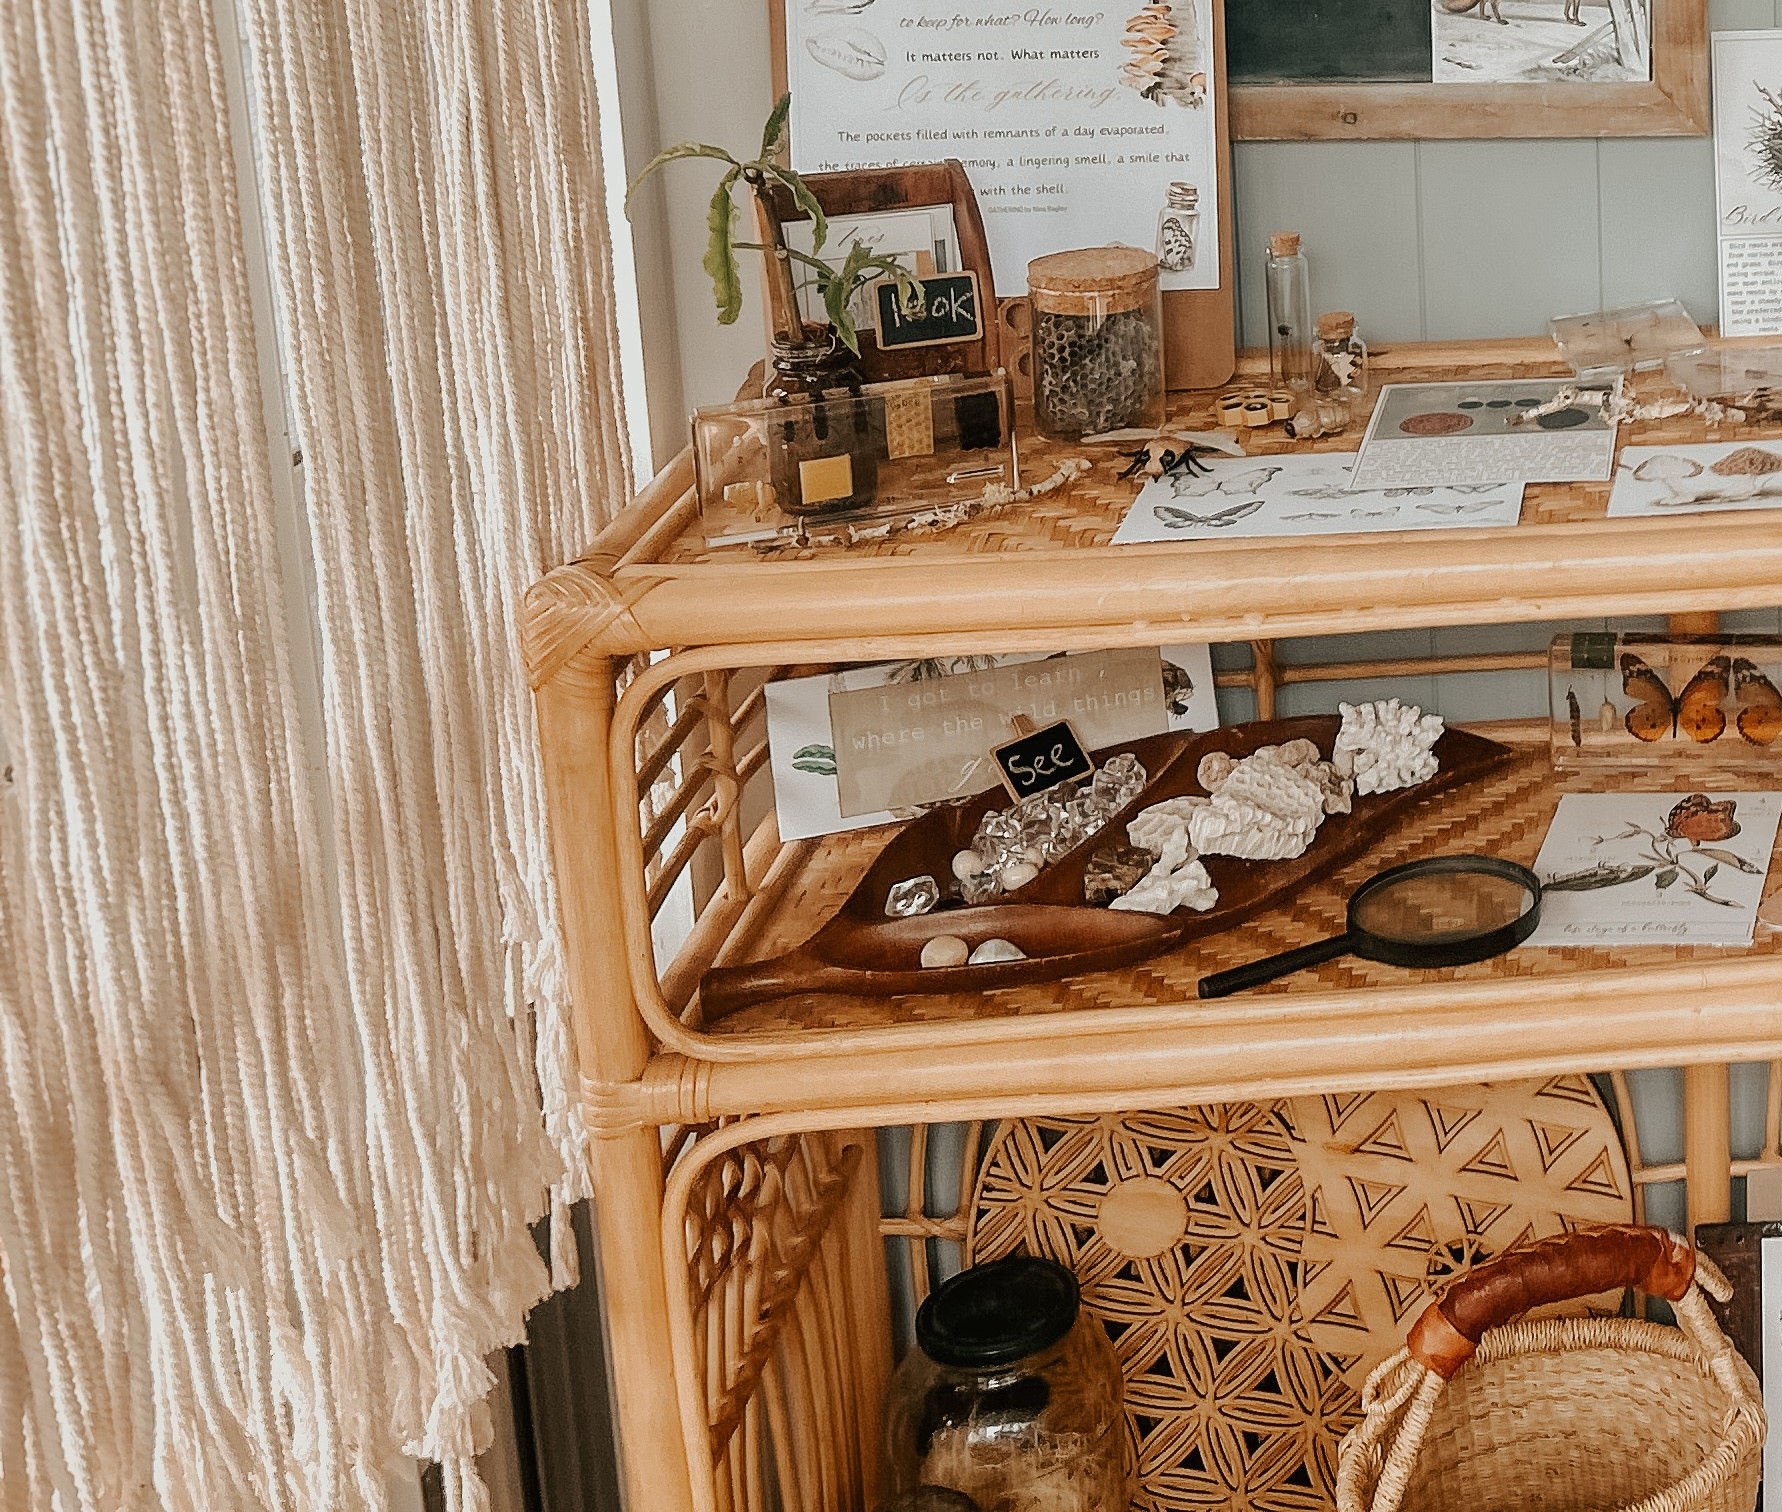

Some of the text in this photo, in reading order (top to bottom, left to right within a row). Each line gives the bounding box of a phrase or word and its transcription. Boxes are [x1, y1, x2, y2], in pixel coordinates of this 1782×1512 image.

[906, 50, 917, 64] It
[921, 51, 972, 63] matters
[1010, 48, 1045, 61] What
[1050, 49, 1100, 60] matters
[837, 130, 861, 144] The
[865, 131, 912, 145] pockets
[915, 127, 948, 141] filled
[952, 128, 979, 141] with
[983, 128, 1041, 140] remnants
[1044, 125, 1058, 139] of
[1061, 127, 1070, 137] a
[1073, 124, 1095, 140] day
[818, 160, 840, 172] the
[1006, 159, 1015, 169] a
[1018, 154, 1070, 170] lingering
[1116, 155, 1125, 166] a
[1129, 153, 1160, 165] smile
[1165, 151, 1190, 165] that
[979, 184, 1006, 198] with
[1010, 183, 1031, 197] the
[908, 688, 950, 713] got
[969, 680, 996, 698] to
[852, 728, 926, 752] where
[942, 715, 985, 738] the
[1072, 685, 1156, 714] things
[1006, 743, 1075, 786] See
